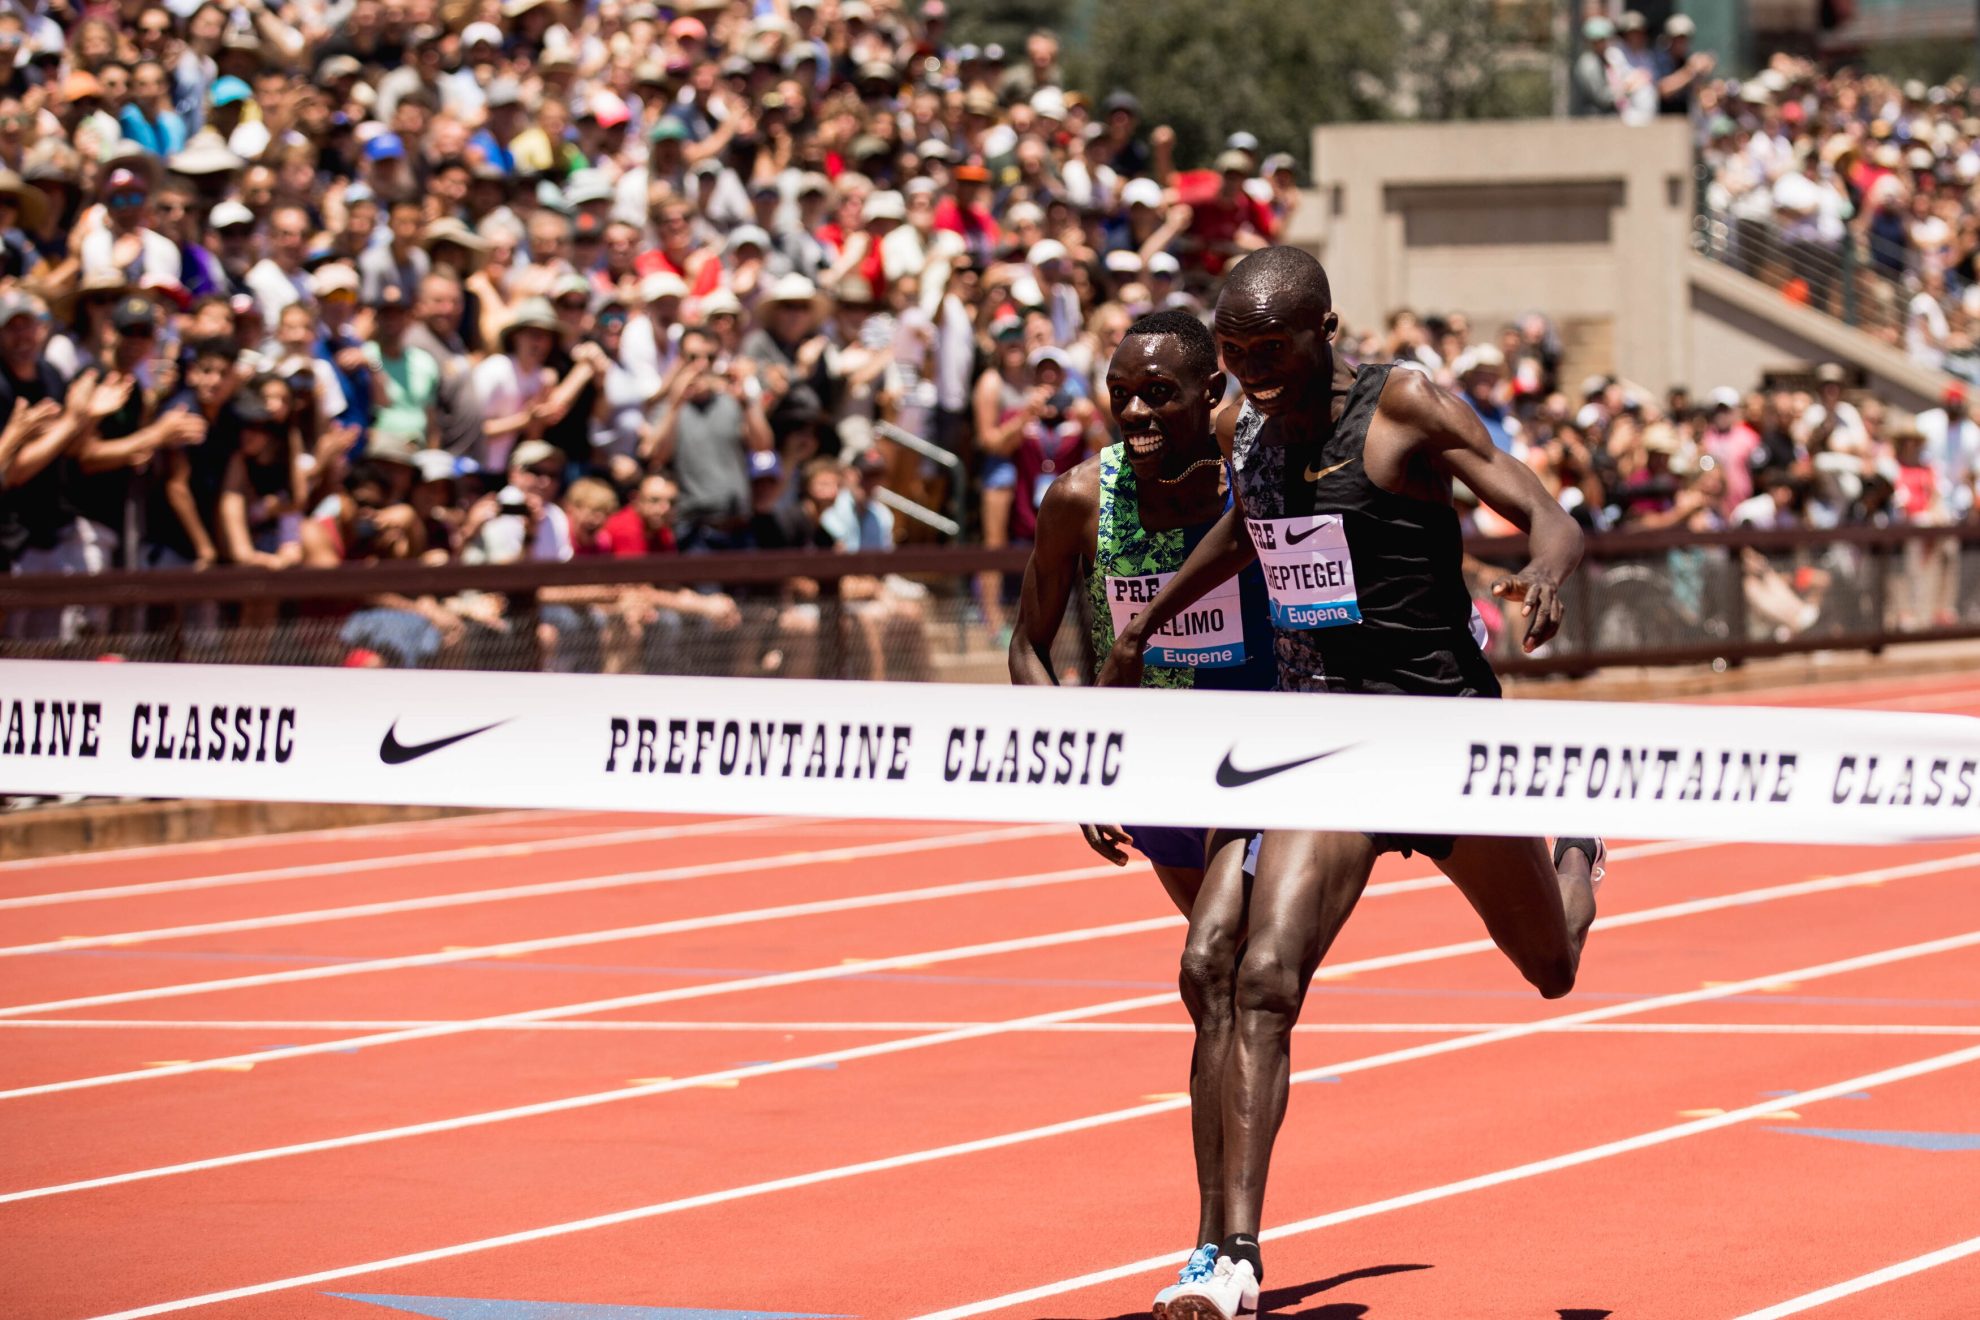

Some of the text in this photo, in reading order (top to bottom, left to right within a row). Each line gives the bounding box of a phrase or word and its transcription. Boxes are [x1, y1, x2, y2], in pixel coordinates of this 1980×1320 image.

[1248, 522, 1277, 550] PRE
[1114, 578, 1160, 603] PRE
[1130, 608, 1224, 636] ELIMO
[1287, 606, 1348, 625] Eugene
[1162, 648, 1233, 666] Eugene
[0, 699, 1980, 807] AINE CLASSIC PREFONTAINE CLASSIC PREFONTAINE CLASS
